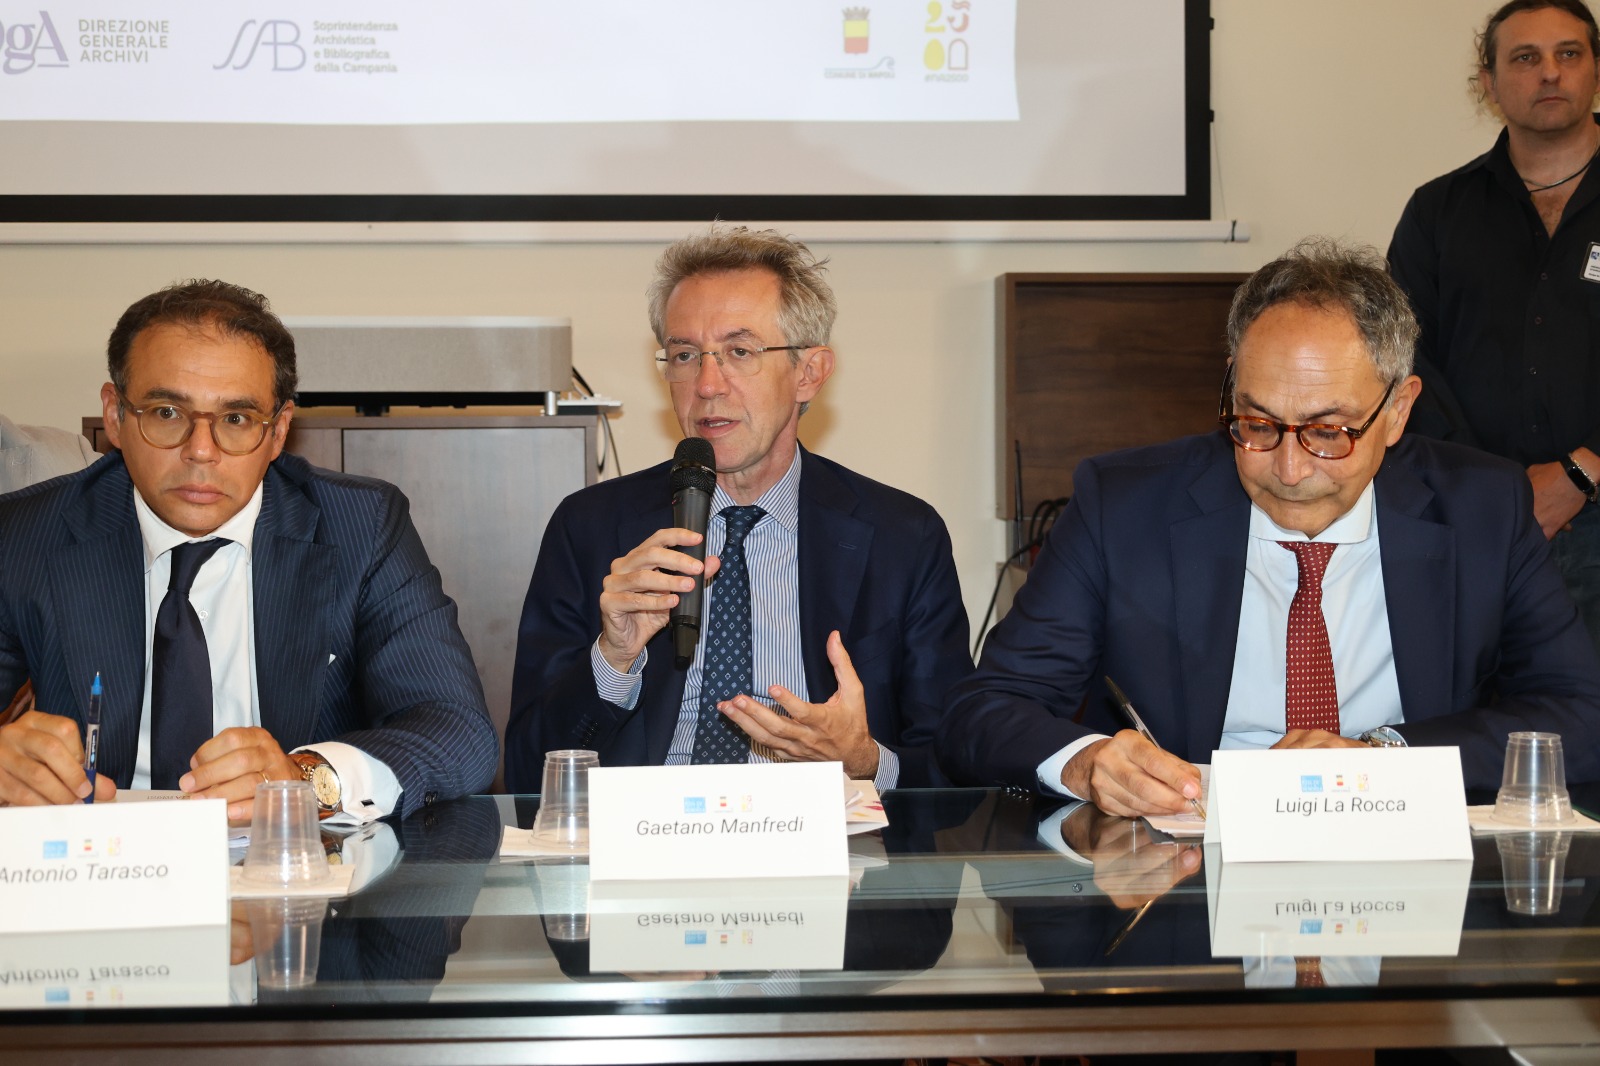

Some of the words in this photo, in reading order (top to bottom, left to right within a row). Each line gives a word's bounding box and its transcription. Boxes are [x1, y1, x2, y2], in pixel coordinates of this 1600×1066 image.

[78, 18, 169, 33] DIREZIONE
[312, 20, 399, 33] Soprintendenza
[0, 10, 70, 75] gA
[78, 34, 168, 49] GENERALE
[312, 34, 376, 46] Archivistica
[79, 50, 149, 63] ARCHIVI
[313, 50, 321, 60] e
[323, 48, 391, 61] Bibliografica
[313, 62, 340, 74] della
[342, 62, 399, 75] Campania
[1275, 797, 1318, 817] Luigi
[1324, 798, 1345, 813] La
[1351, 797, 1406, 813] Rocca
[636, 819, 714, 836] Gaetano
[720, 816, 804, 834] Manfredi
[0, 865, 78, 884] Antonio
[86, 863, 169, 881] Tarasco
